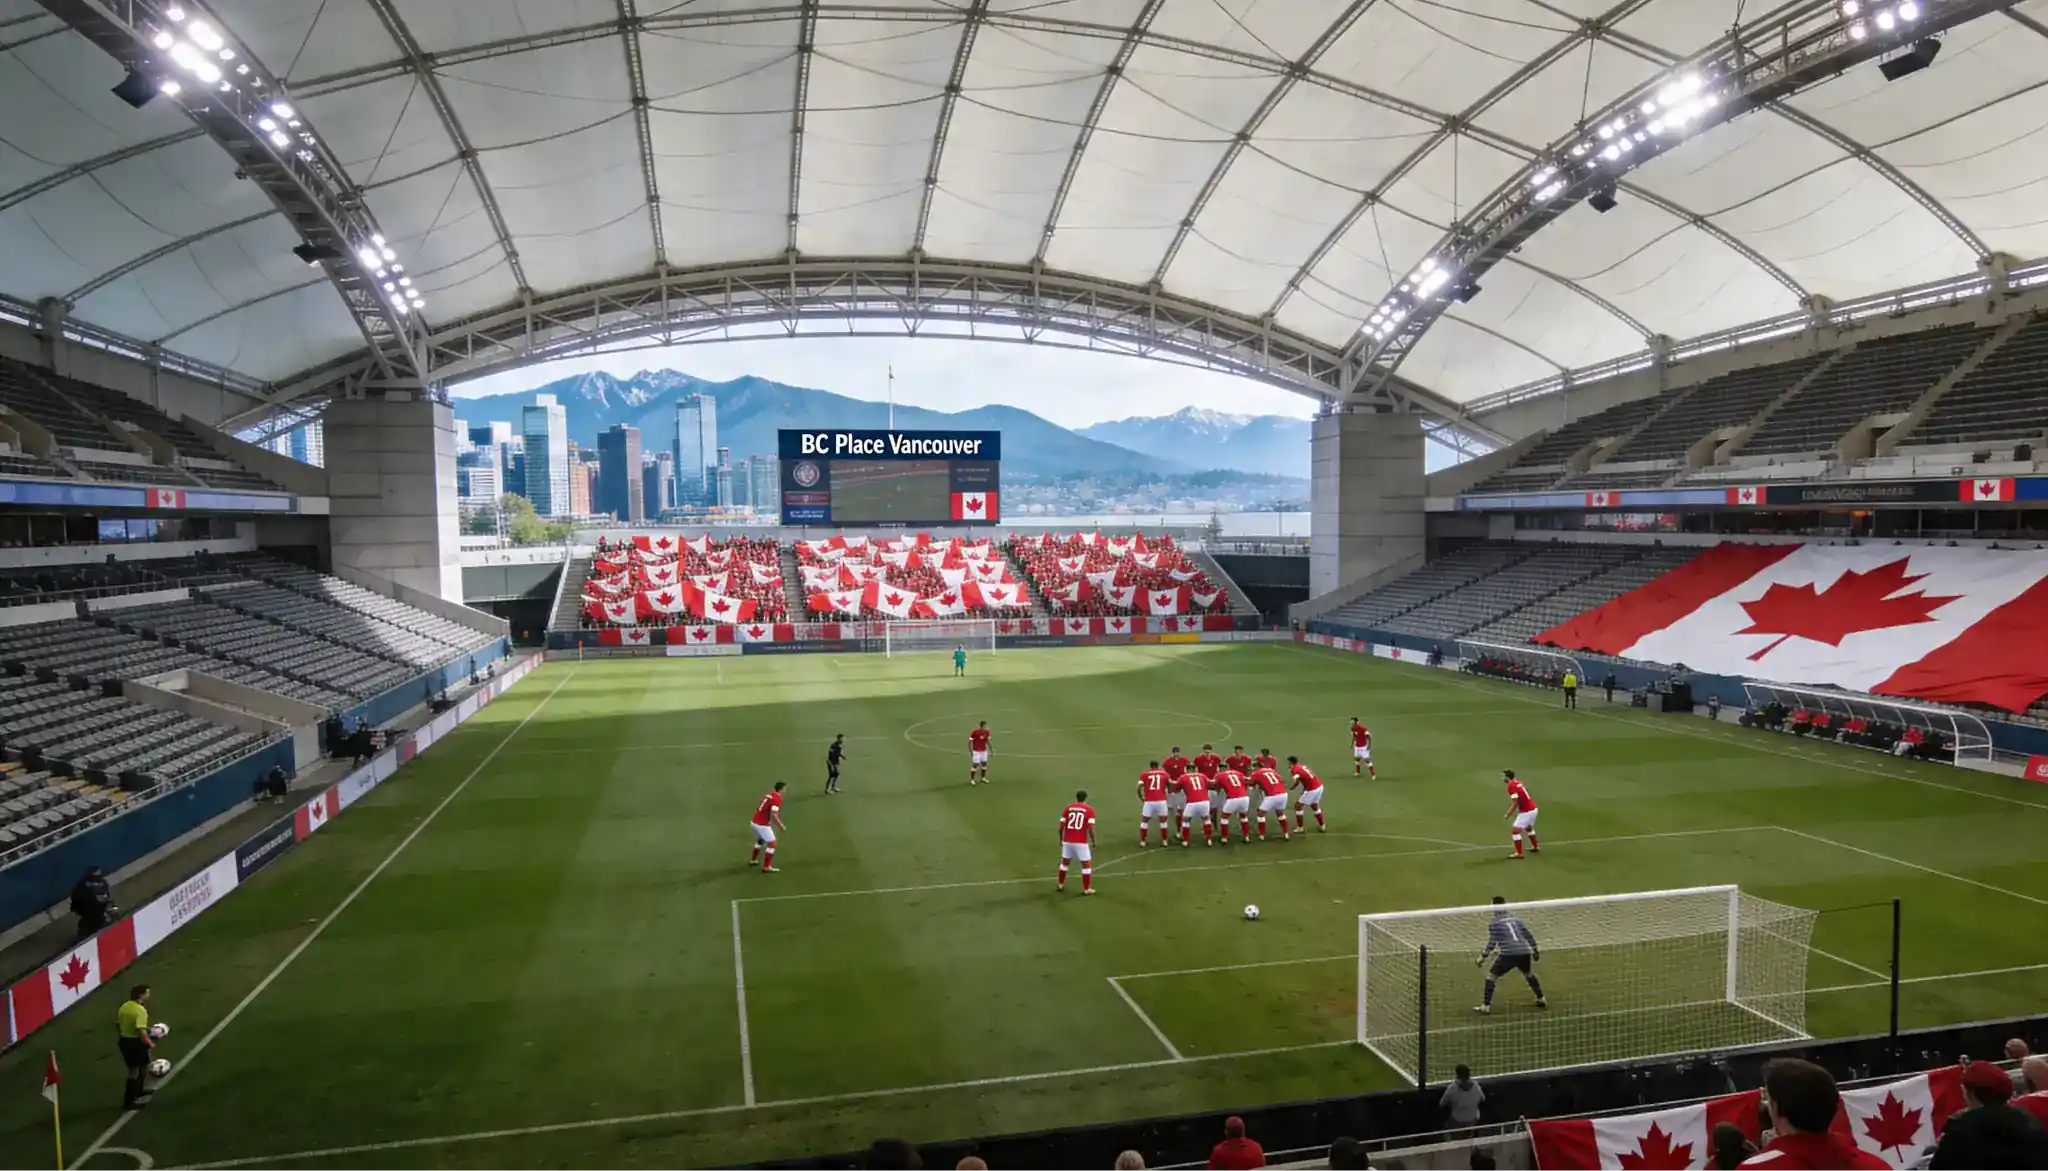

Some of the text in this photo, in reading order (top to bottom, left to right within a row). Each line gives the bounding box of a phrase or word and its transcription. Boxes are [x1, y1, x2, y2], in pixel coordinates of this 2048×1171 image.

[801, 433, 982, 454] BC Place Vancouver
[1148, 774, 1161, 790] 21
[1067, 811, 1085, 830] 20
